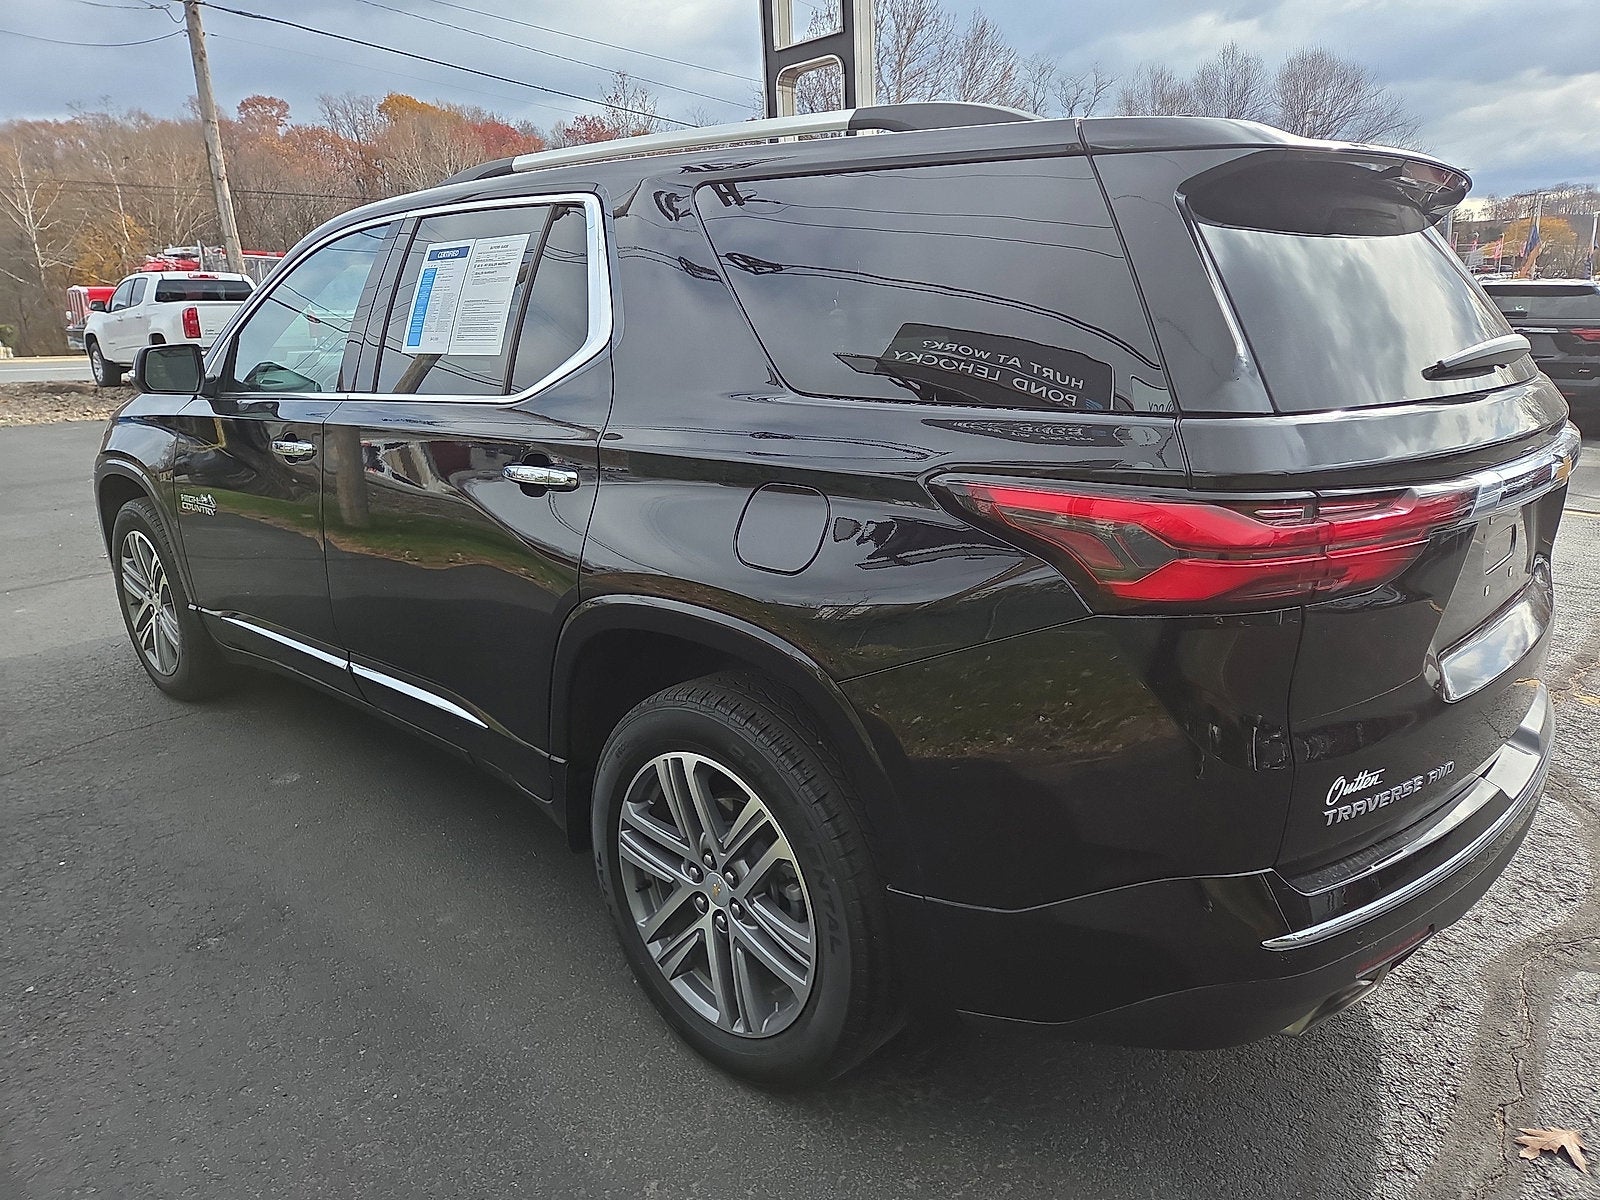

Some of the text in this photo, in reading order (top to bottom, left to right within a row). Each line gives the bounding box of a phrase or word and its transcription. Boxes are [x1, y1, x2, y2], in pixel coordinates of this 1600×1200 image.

[181, 502, 216, 516] COUNTRY
[1322, 760, 1456, 826] TRAVERSE AWD
[1325, 768, 1386, 806] Outten
